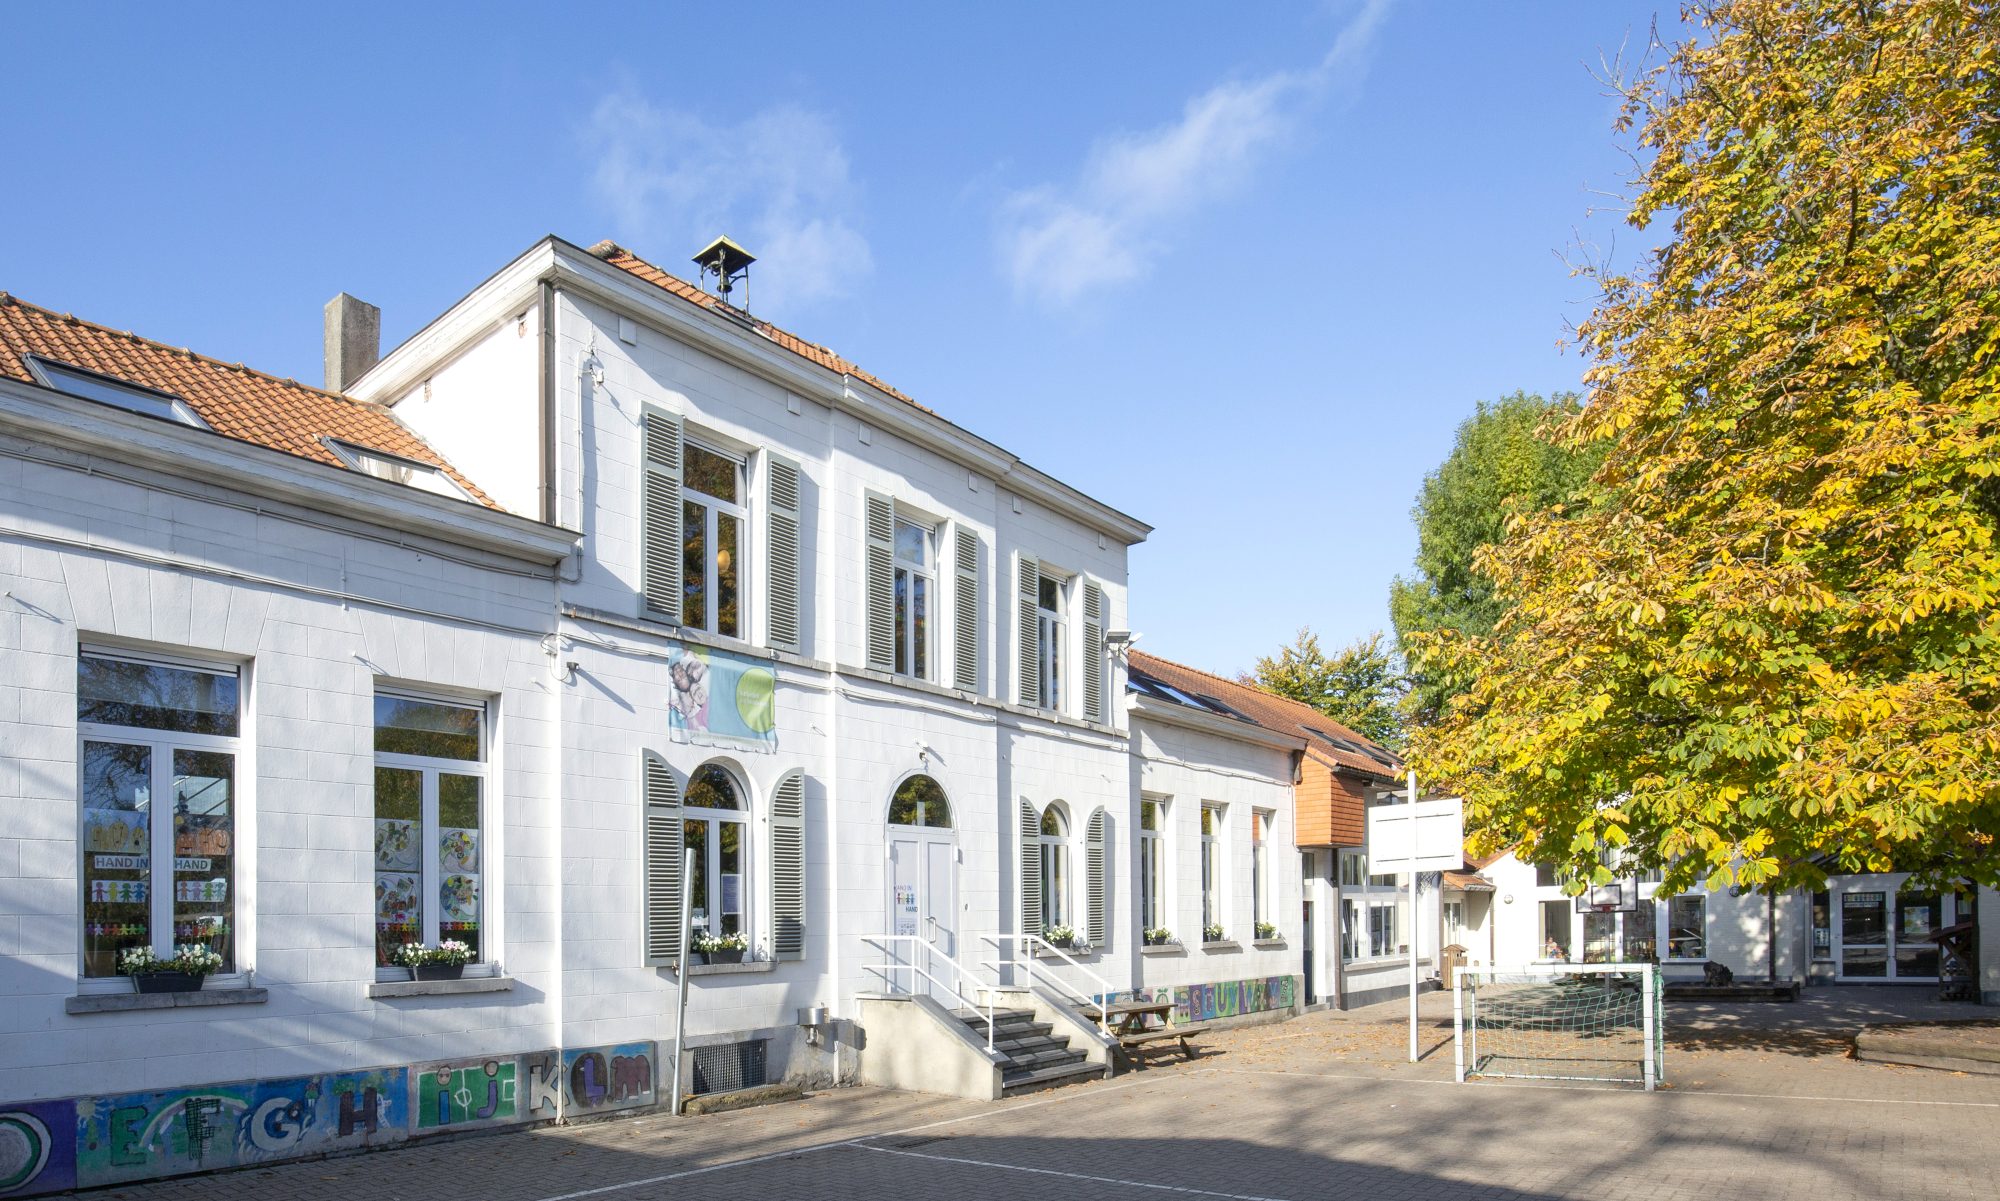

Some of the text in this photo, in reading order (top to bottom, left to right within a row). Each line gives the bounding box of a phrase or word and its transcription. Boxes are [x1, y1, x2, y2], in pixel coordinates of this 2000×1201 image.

[96, 857, 208, 870] HAND IN HAND
[110, 1105, 148, 1166] E
[185, 1097, 221, 1160] F
[251, 1097, 301, 1150] G
[338, 1086, 378, 1138] H
[529, 1064, 571, 1111] K
[583, 1057, 607, 1098] L
